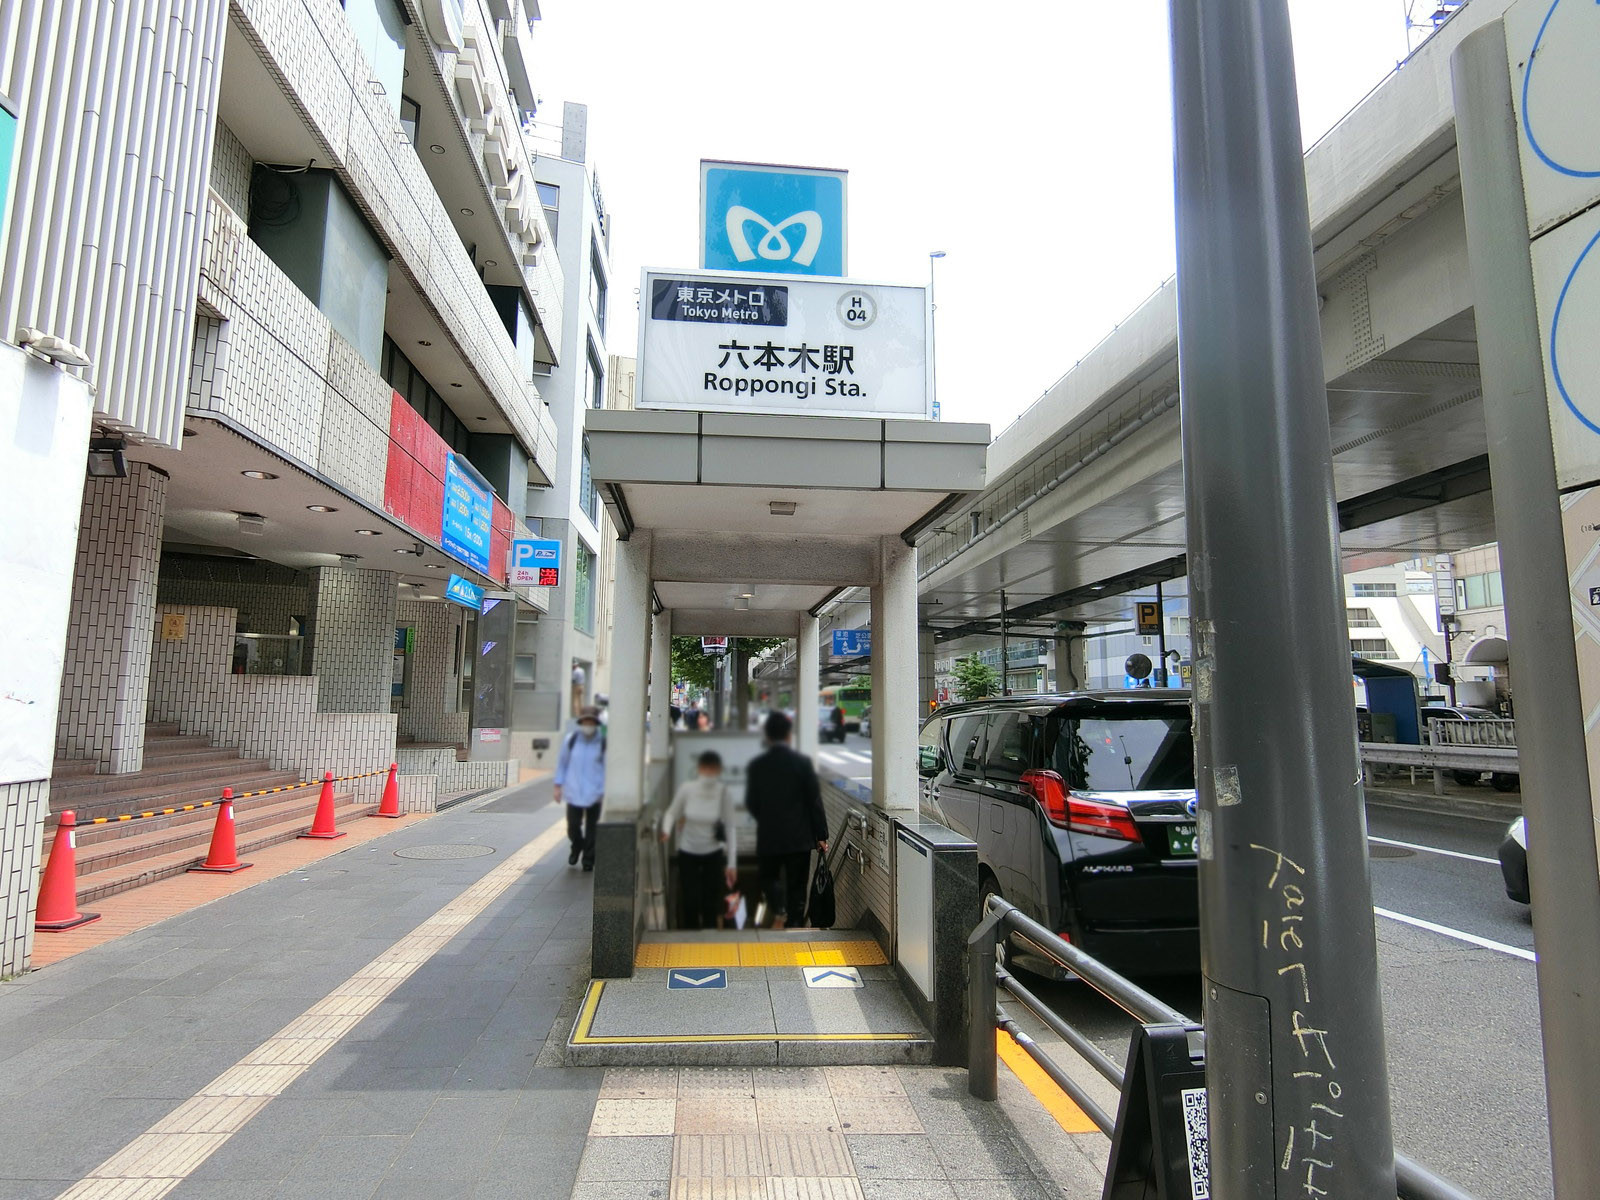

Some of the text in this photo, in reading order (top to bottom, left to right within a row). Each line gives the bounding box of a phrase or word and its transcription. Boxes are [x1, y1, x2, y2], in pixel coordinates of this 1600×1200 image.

[676, 285, 765, 307] 東京メトロ
[851, 296, 862, 308] H
[682, 305, 759, 321] Tokyo Metro
[846, 309, 867, 322] 04
[717, 339, 855, 376] 六本木駅
[703, 372, 868, 400] Roppongi Sta.
[515, 544, 534, 569] P
[540, 568, 557, 586] 満
[1141, 604, 1155, 623] P
[1082, 865, 1134, 873] ALPHARD
